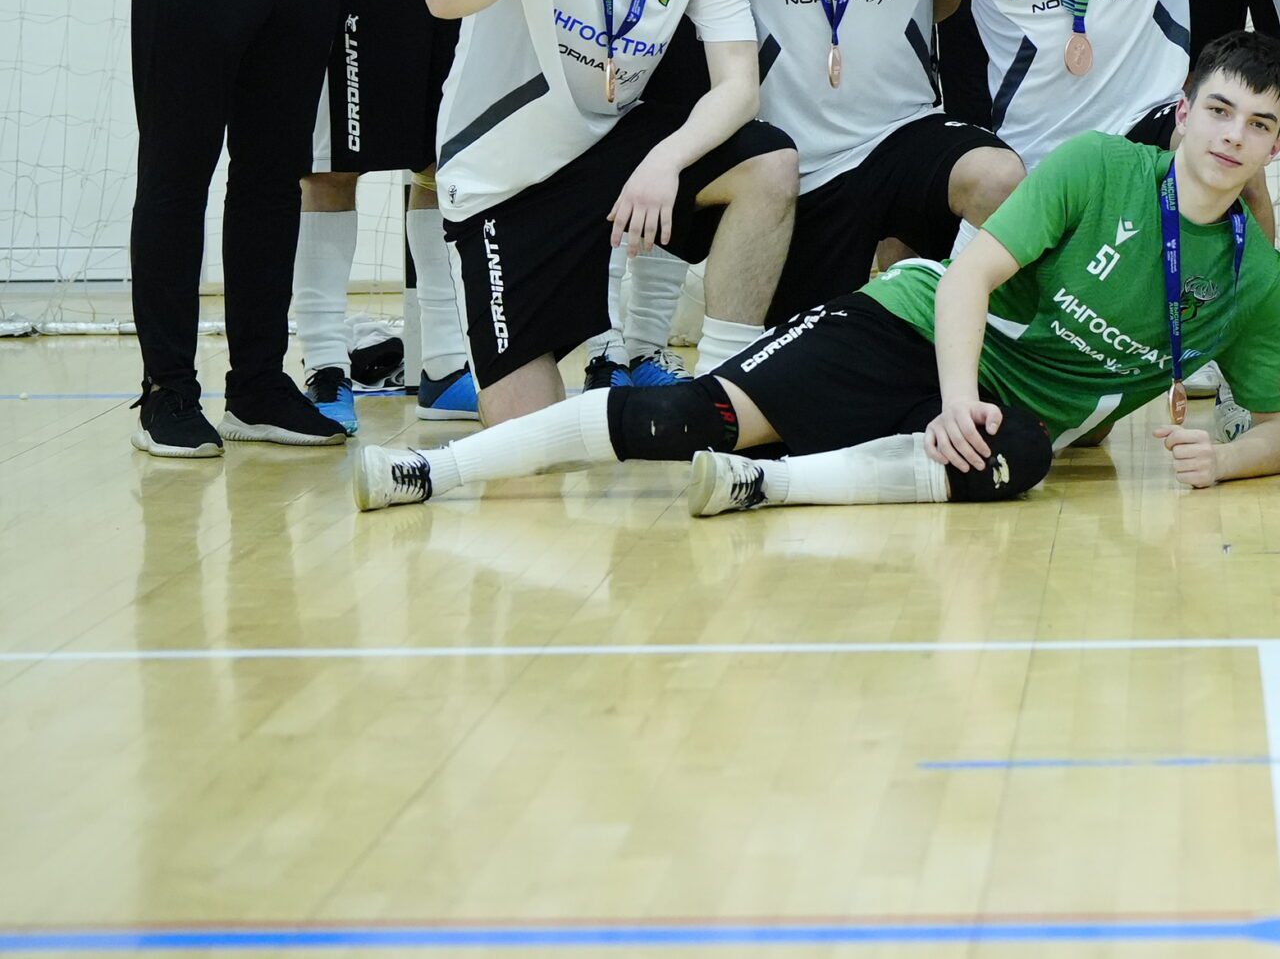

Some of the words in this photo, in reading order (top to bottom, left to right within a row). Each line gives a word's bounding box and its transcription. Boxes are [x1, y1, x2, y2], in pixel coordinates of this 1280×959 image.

[345, 34, 361, 153] CORDIANT
[484, 238, 509, 355] CORDIANT
[1087, 244, 1121, 281] 51
[1053, 288, 1172, 369] ИНГОССТРАХ
